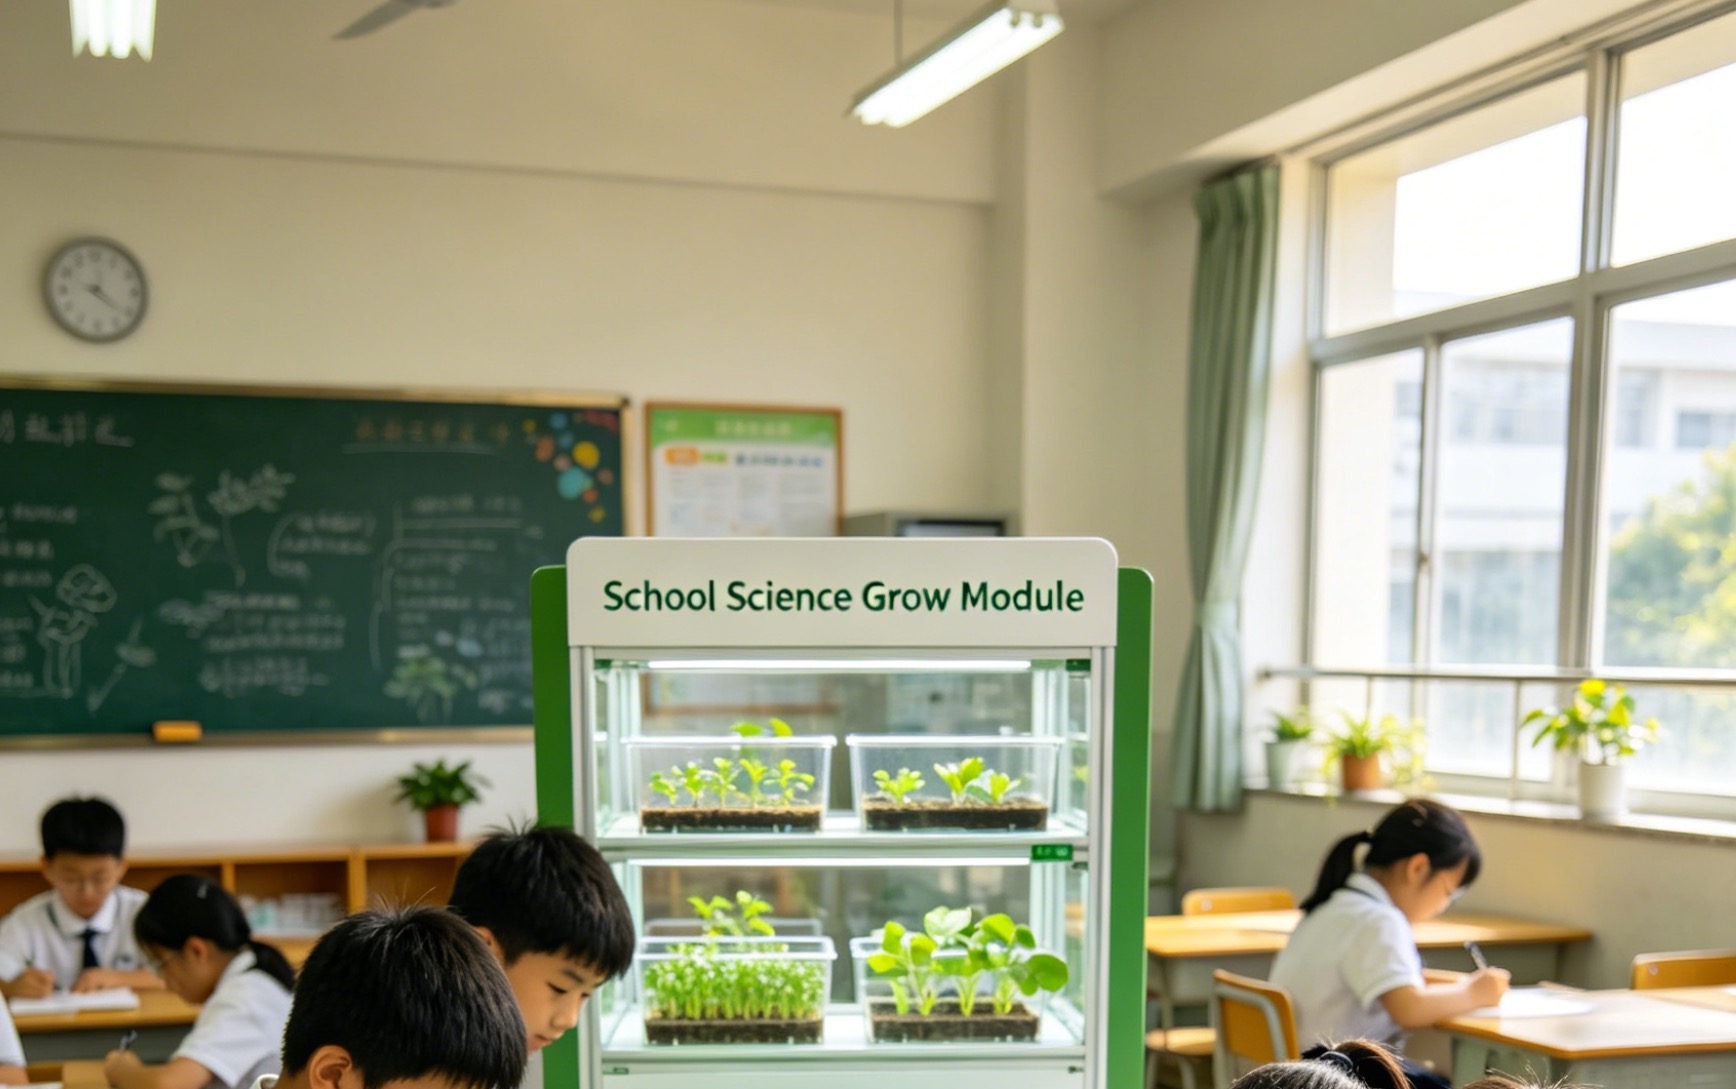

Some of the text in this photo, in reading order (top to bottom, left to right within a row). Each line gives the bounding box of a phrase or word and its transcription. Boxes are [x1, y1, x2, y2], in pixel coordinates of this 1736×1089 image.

[603, 579, 1085, 612] School Science Grow Module
